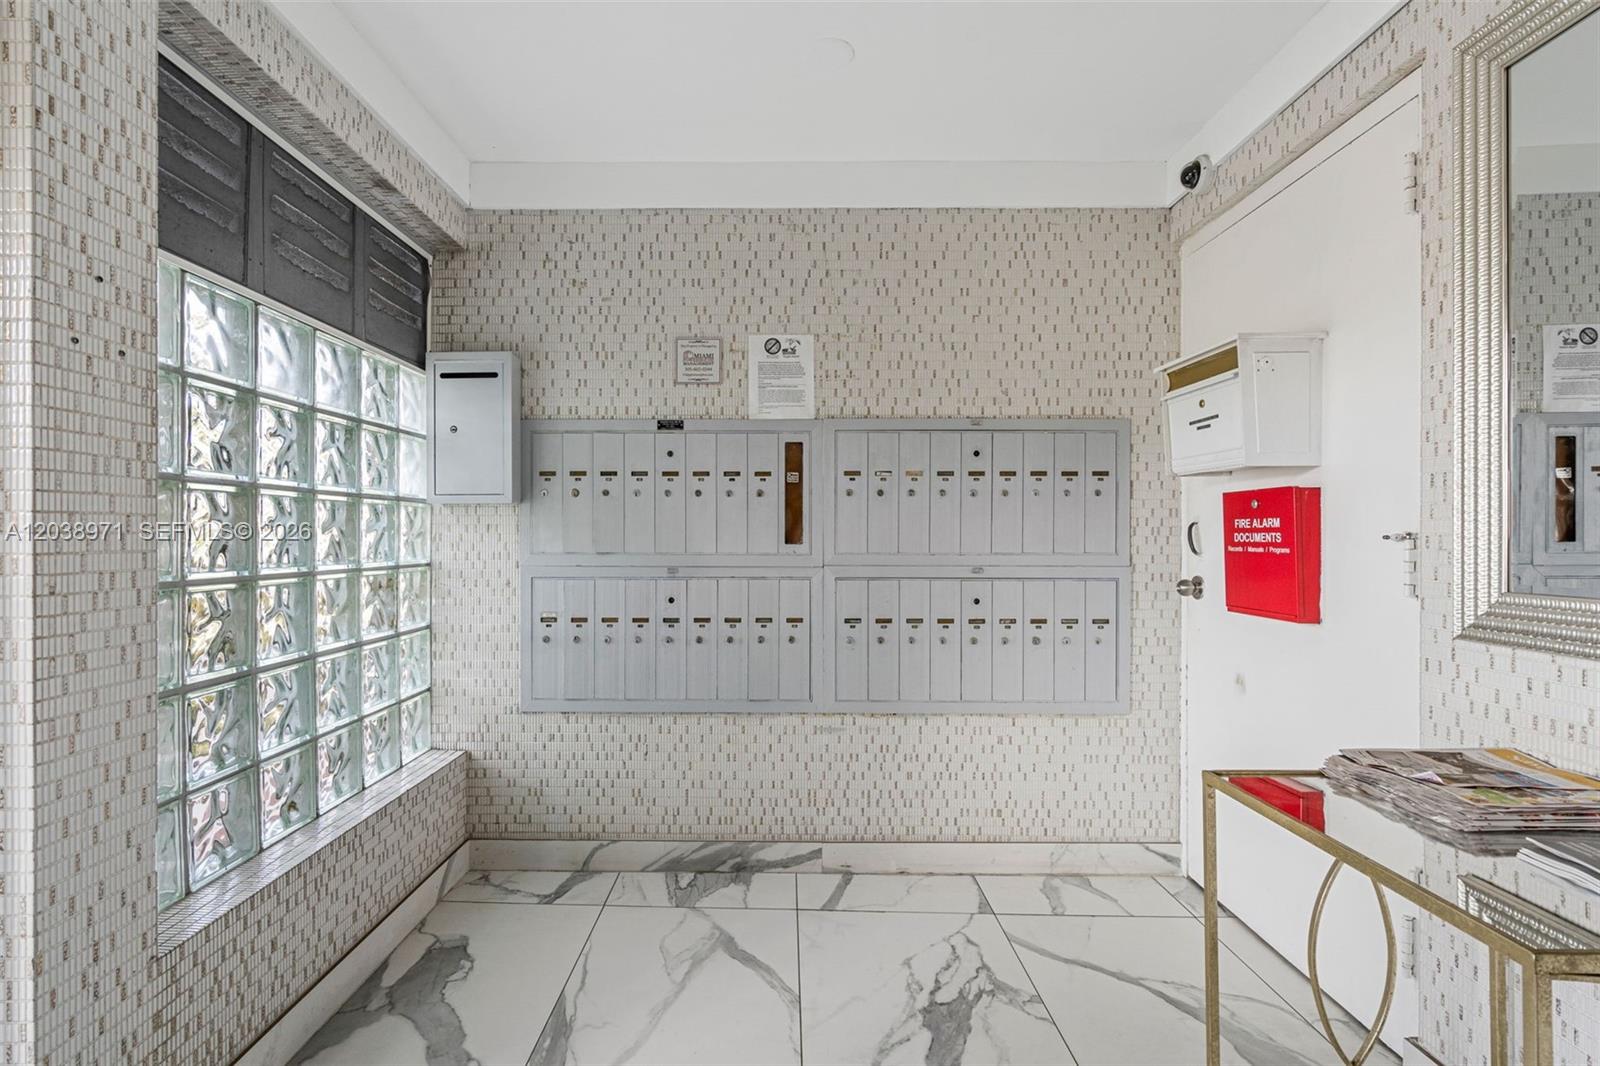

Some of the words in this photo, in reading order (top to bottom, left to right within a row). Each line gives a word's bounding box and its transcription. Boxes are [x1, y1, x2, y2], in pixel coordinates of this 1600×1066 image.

[1235, 518, 1251, 528] FIRE
[1252, 518, 1280, 528] ALARM
[1234, 532, 1282, 543] DOCUMENTS
[1269, 546, 1290, 554] Programs
